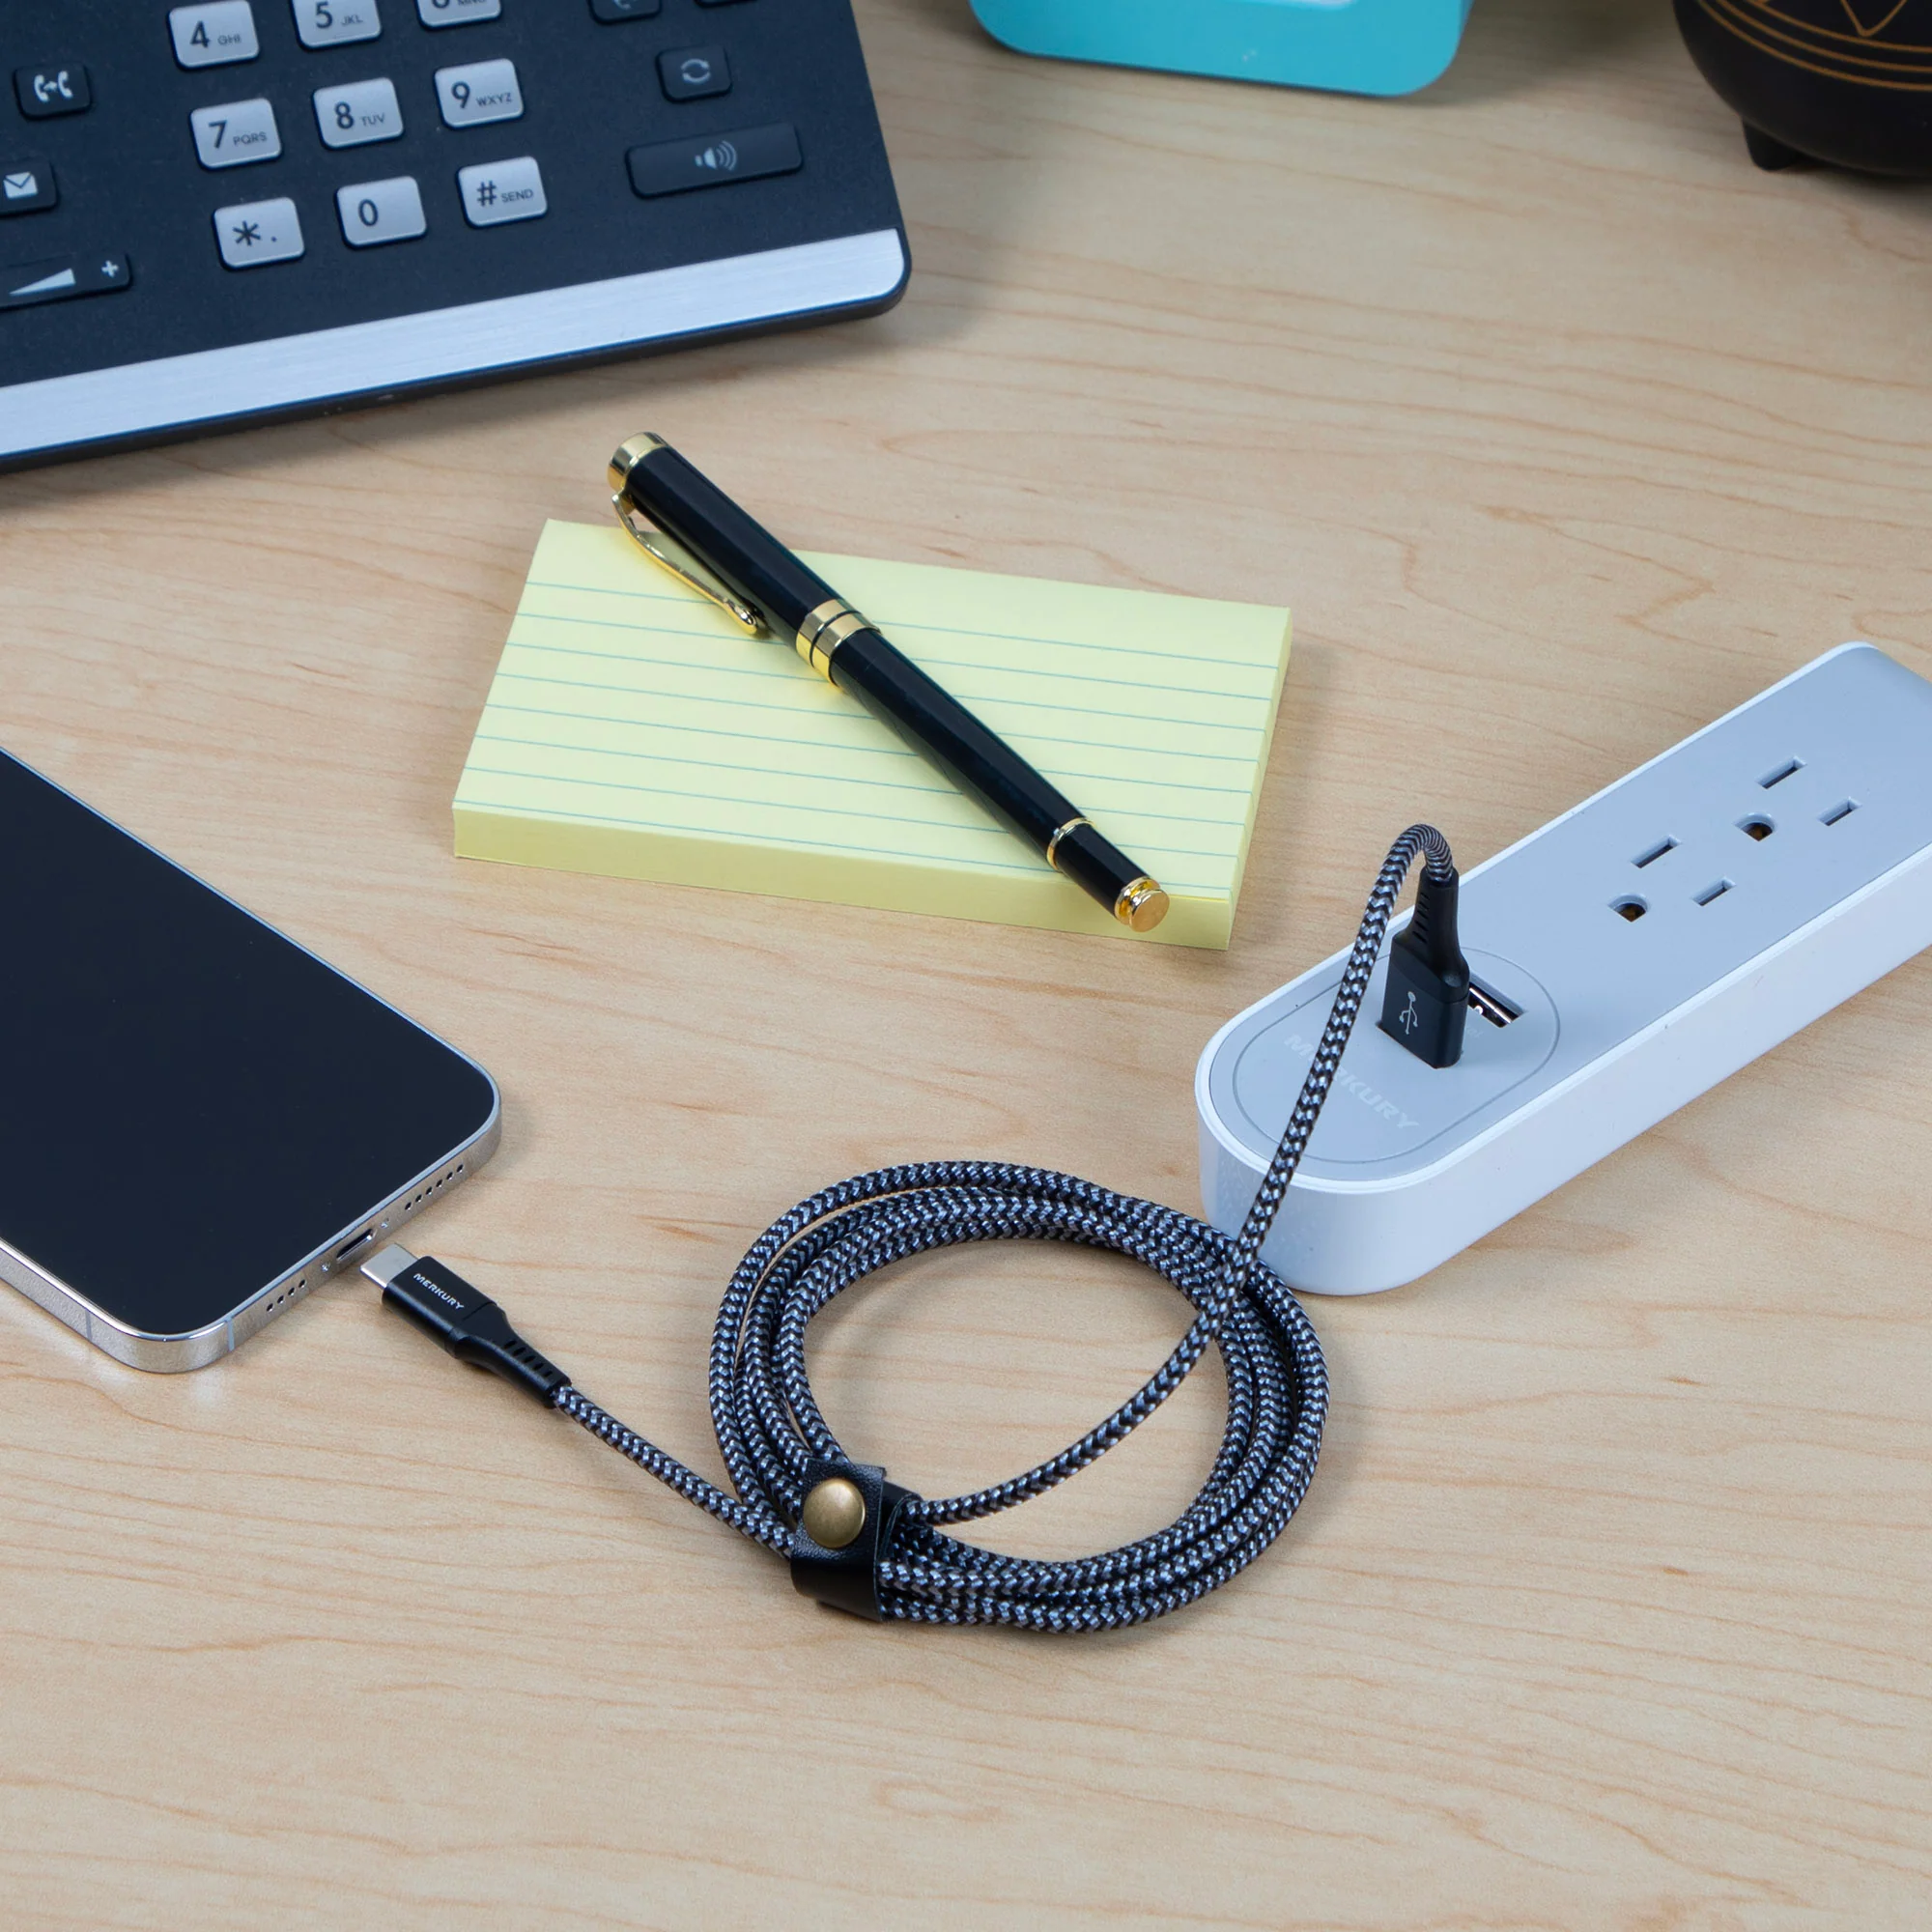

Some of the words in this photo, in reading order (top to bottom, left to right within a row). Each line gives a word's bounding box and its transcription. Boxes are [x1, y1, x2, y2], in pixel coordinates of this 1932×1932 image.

[315, 1, 333, 29] 5
[341, 14, 363, 26] JKL
[190, 20, 210, 48] 4
[217, 34, 241, 45] GHI
[451, 81, 470, 109] 9
[476, 93, 512, 106] WXYZ
[334, 101, 355, 129] 8
[360, 113, 385, 127] TUV
[209, 120, 227, 149] 7
[233, 131, 268, 145] PQRS
[500, 189, 533, 203] SEND
[358, 199, 379, 226] 0
[1284, 1034, 1419, 1129] MKURY
[412, 1272, 465, 1310] MERKURY
